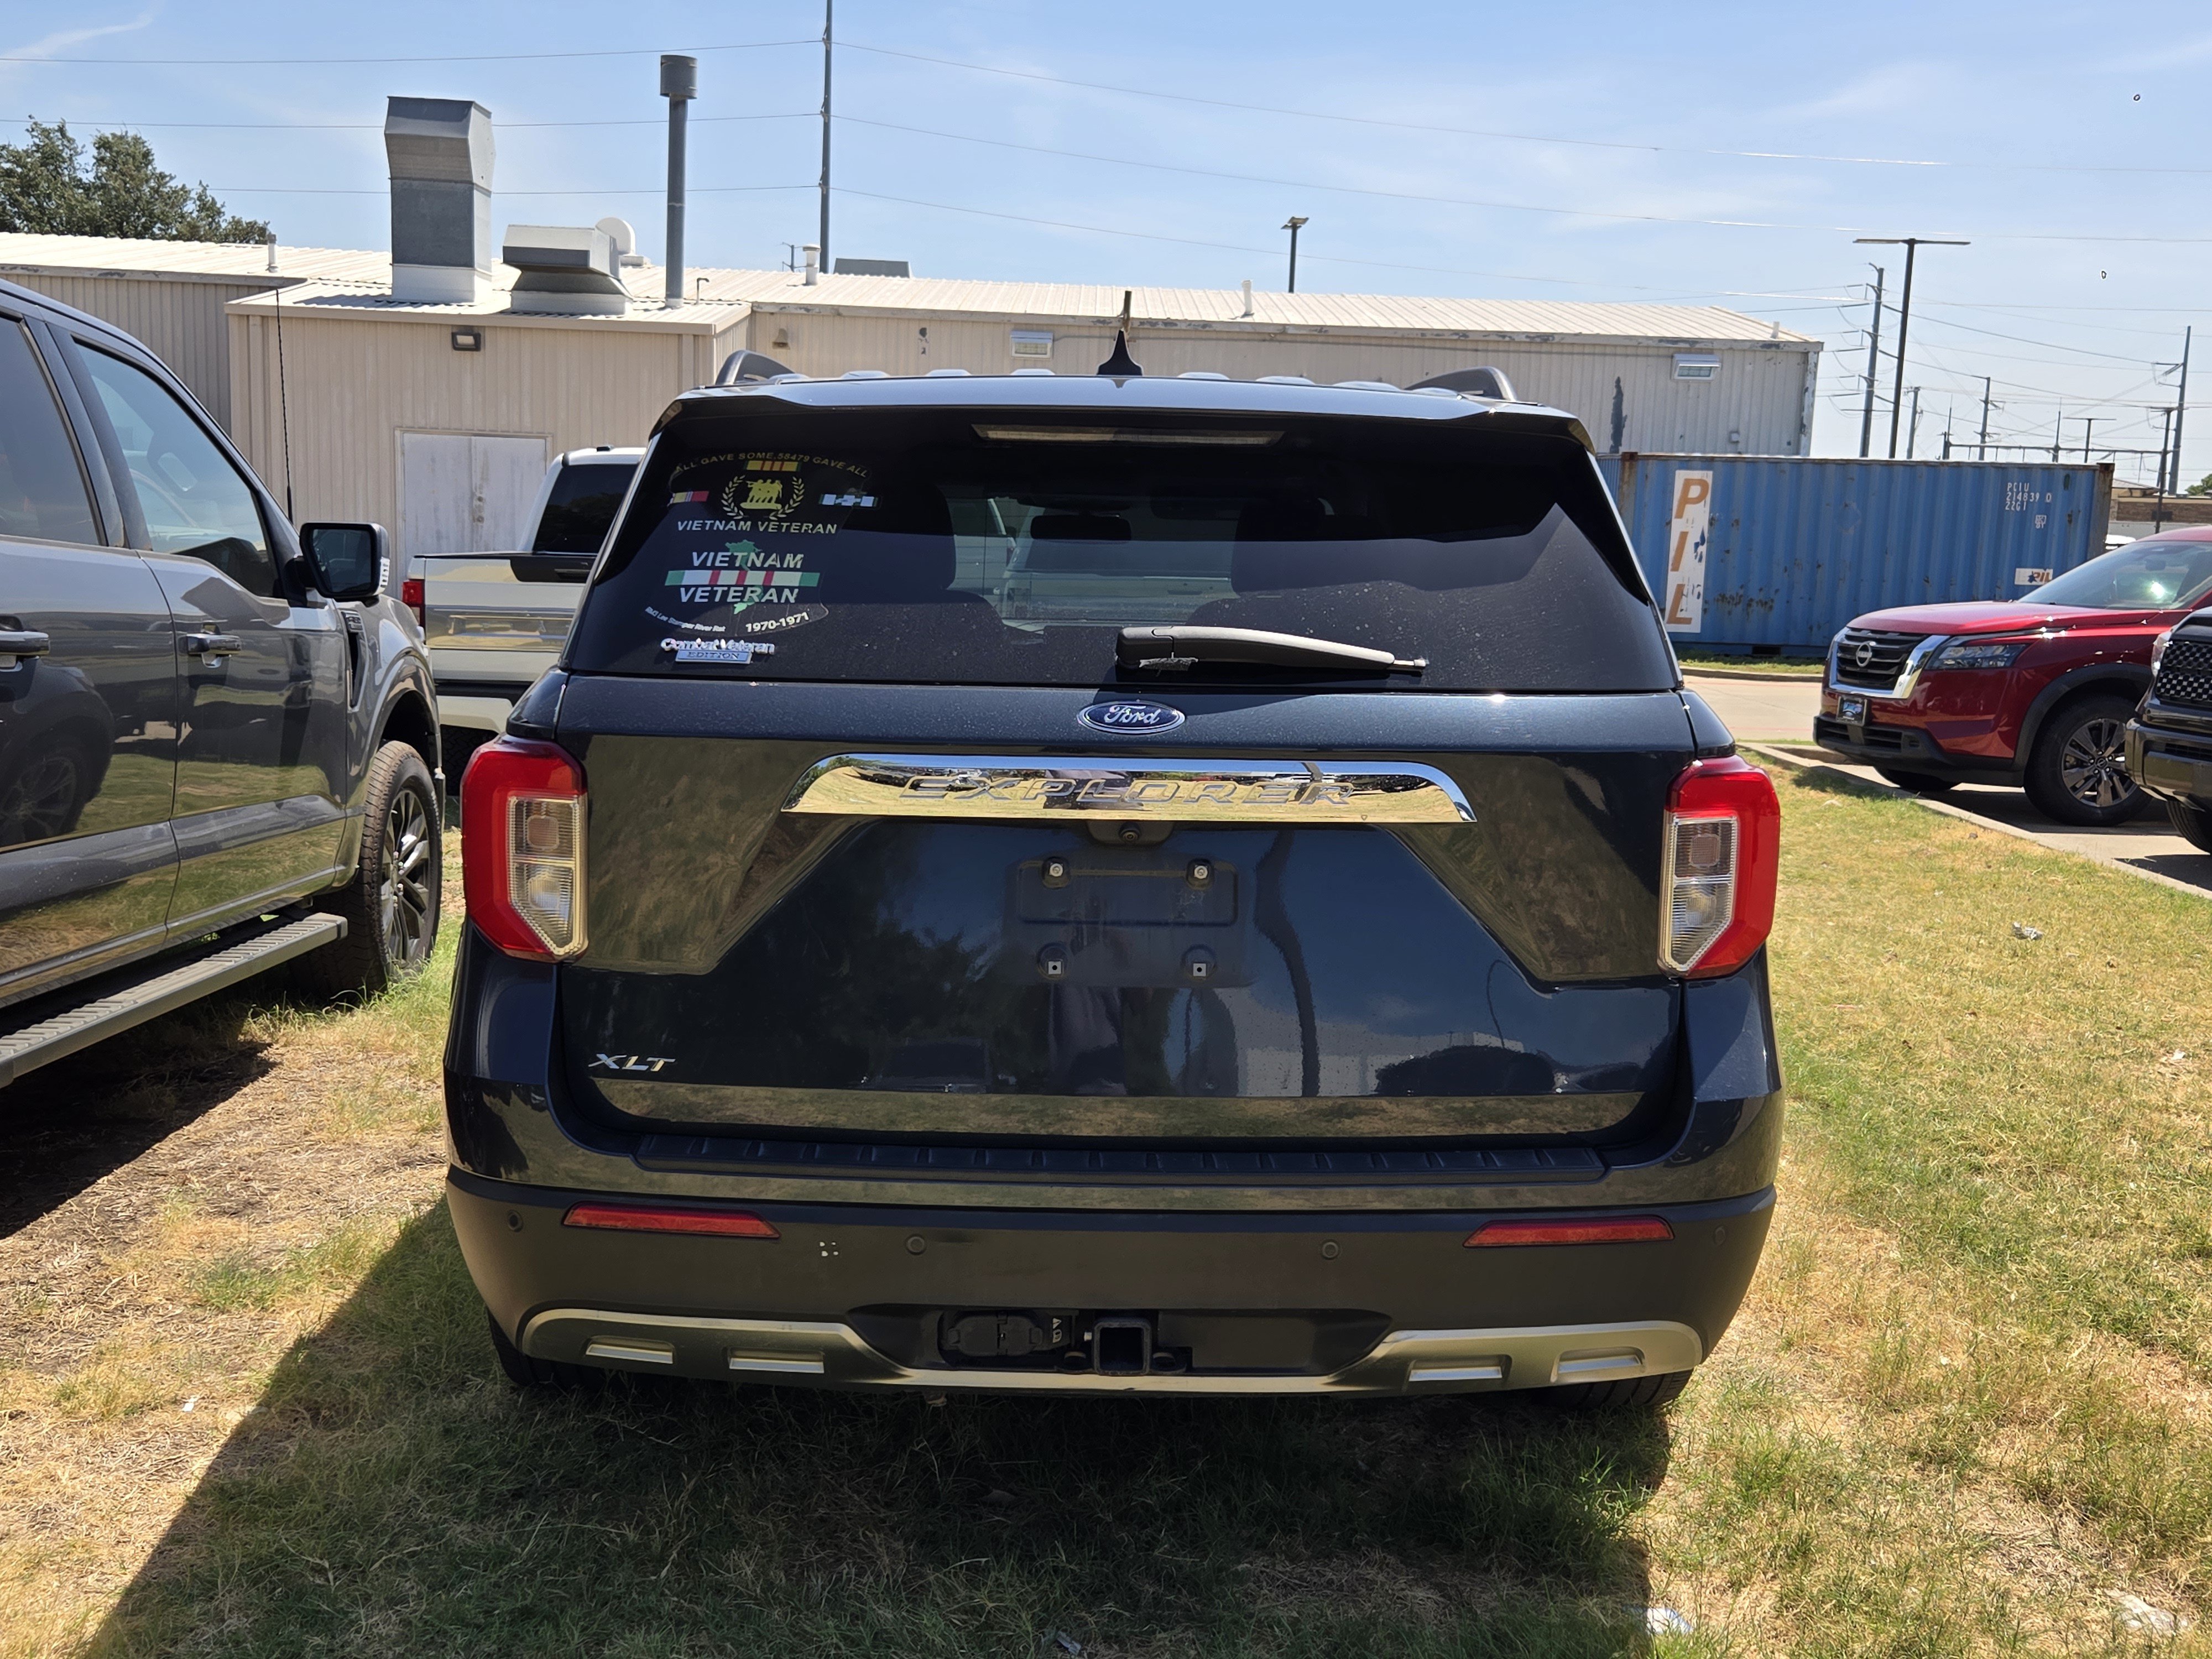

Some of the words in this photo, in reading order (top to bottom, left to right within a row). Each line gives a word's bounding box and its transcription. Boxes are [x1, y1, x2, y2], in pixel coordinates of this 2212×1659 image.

[675, 462, 697, 473] ALL
[701, 453, 734, 465] GAVE
[812, 457, 846, 469] GAVE
[847, 465, 868, 478] ALL
[2007, 482, 2029, 492] PCIU
[2006, 492, 2039, 502] 214839
[2005, 501, 2027, 511] 22G1
[677, 520, 751, 531] VIETNAM
[758, 521, 837, 534] VETERAN
[1666, 478, 1709, 625] PIL
[692, 552, 804, 569] VIETNAM
[680, 587, 799, 603] VETERAN
[746, 612, 810, 632] 1970-1971
[687, 651, 740, 660] EDITION
[1104, 705, 1161, 724] Ford
[899, 774, 1356, 806] EXPLORER
[588, 1053, 676, 1072] XLT
